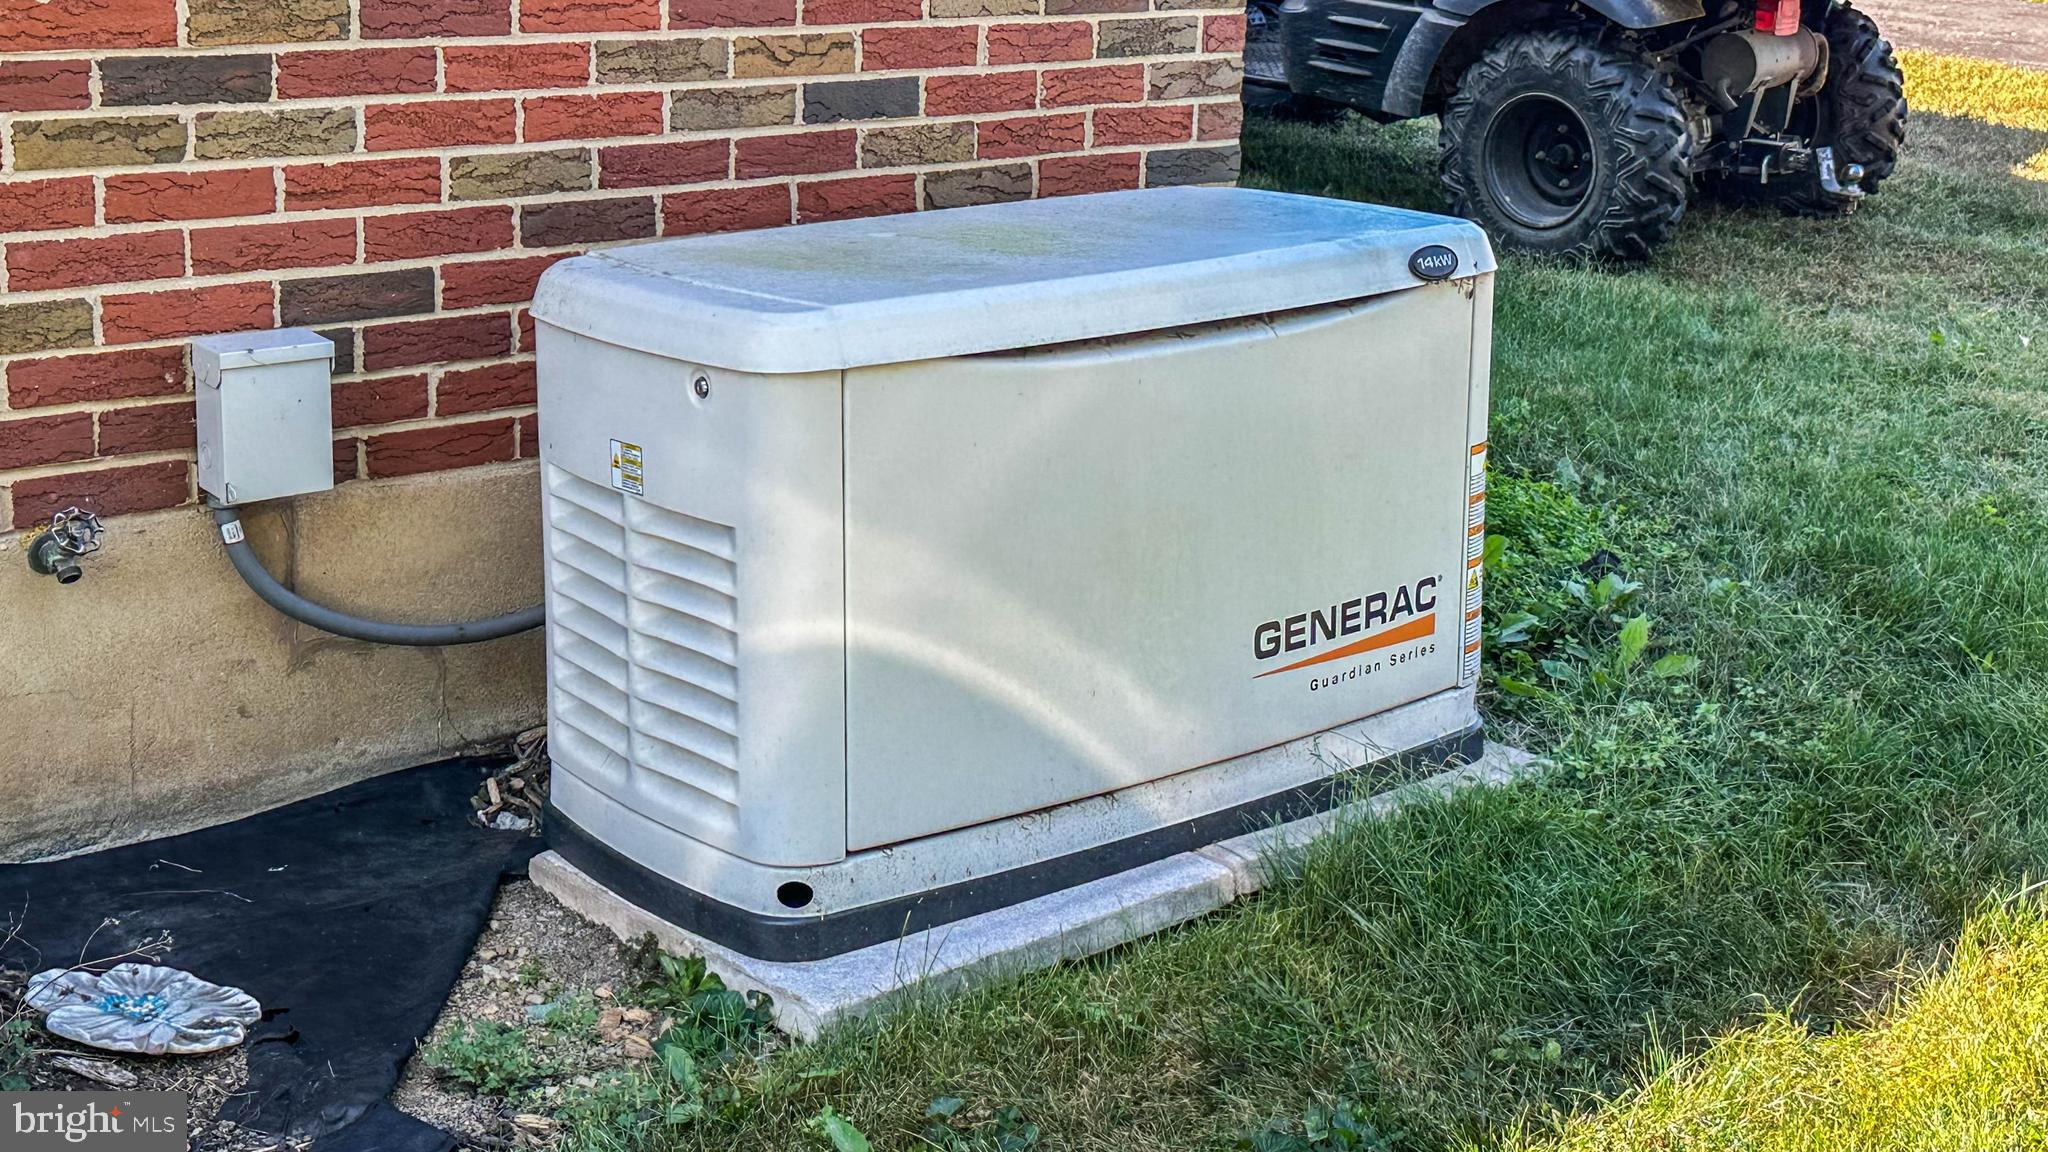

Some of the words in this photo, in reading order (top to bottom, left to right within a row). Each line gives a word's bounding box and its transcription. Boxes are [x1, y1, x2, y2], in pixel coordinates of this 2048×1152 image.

[1416, 253, 1452, 270] 14kW
[1254, 576, 1437, 660] GENERAC
[1310, 662, 1381, 691] Guardian
[1389, 643, 1436, 667] Series
